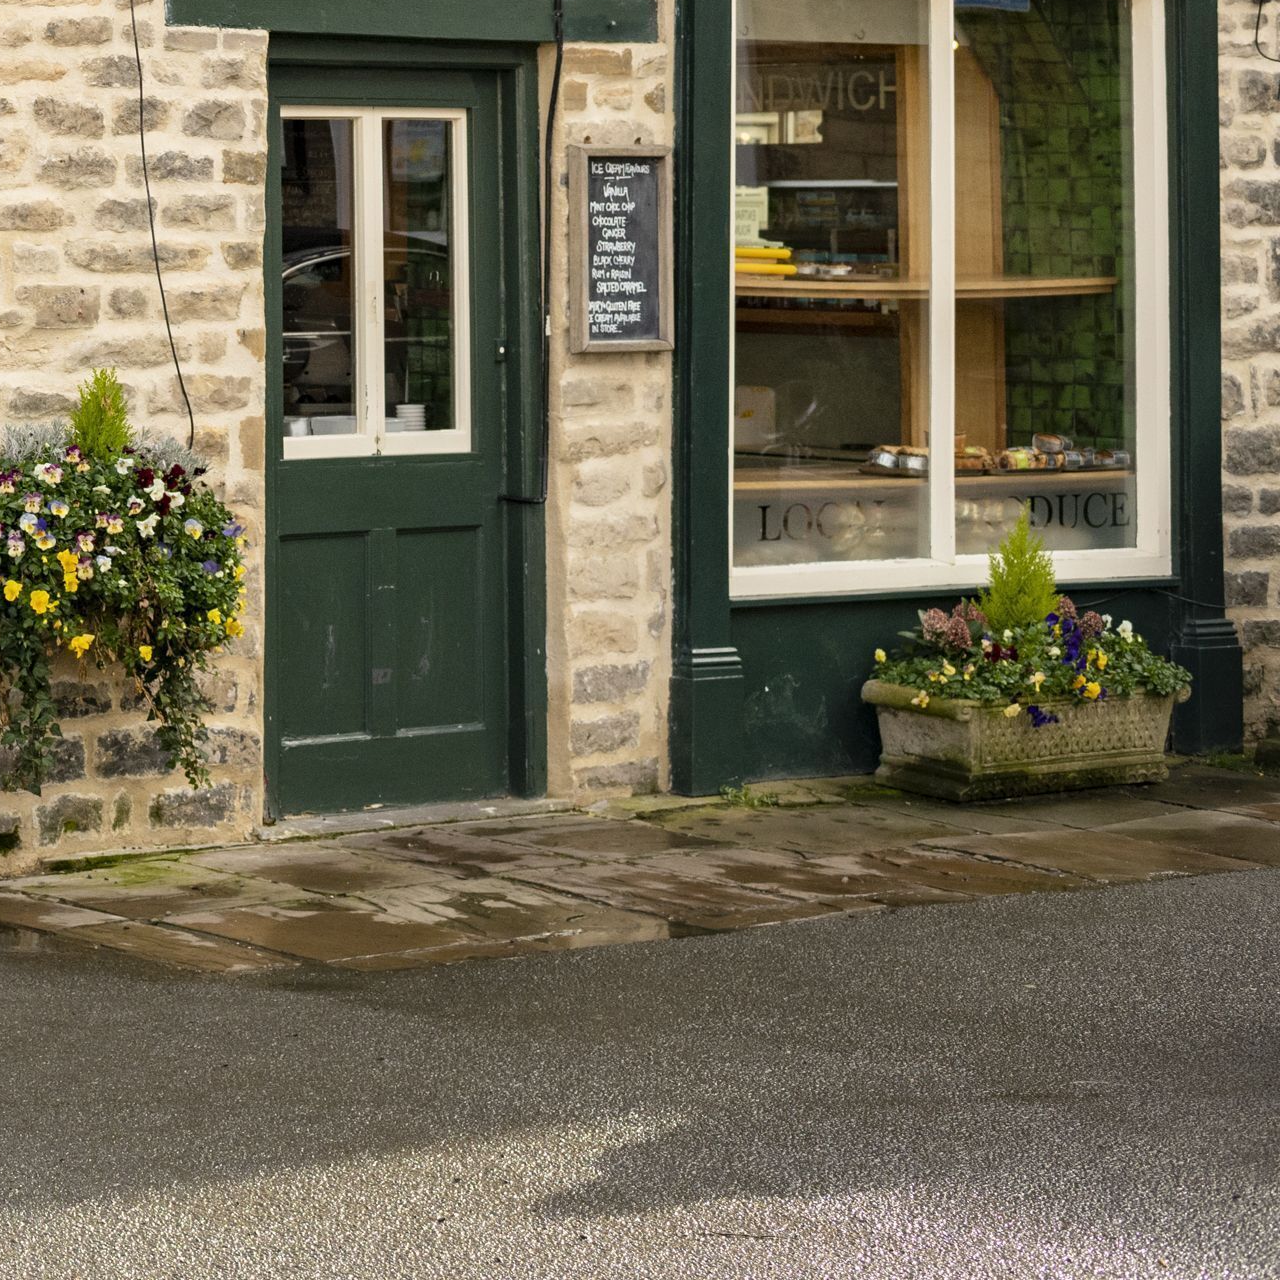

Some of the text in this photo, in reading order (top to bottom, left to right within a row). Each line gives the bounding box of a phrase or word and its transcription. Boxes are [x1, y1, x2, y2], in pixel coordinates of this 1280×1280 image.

[741, 71, 896, 110] NDWICH
[592, 161, 604, 174] ICE
[603, 182, 630, 201] VANILLA
[590, 201, 605, 213] MINT
[592, 215, 627, 228] CHOCOLATE
[602, 228, 626, 240] GINGER
[596, 240, 636, 254] STRAWBERRY
[593, 255, 613, 268] BLACK
[592, 268, 604, 280] RUM
[597, 281, 619, 296] SALTED
